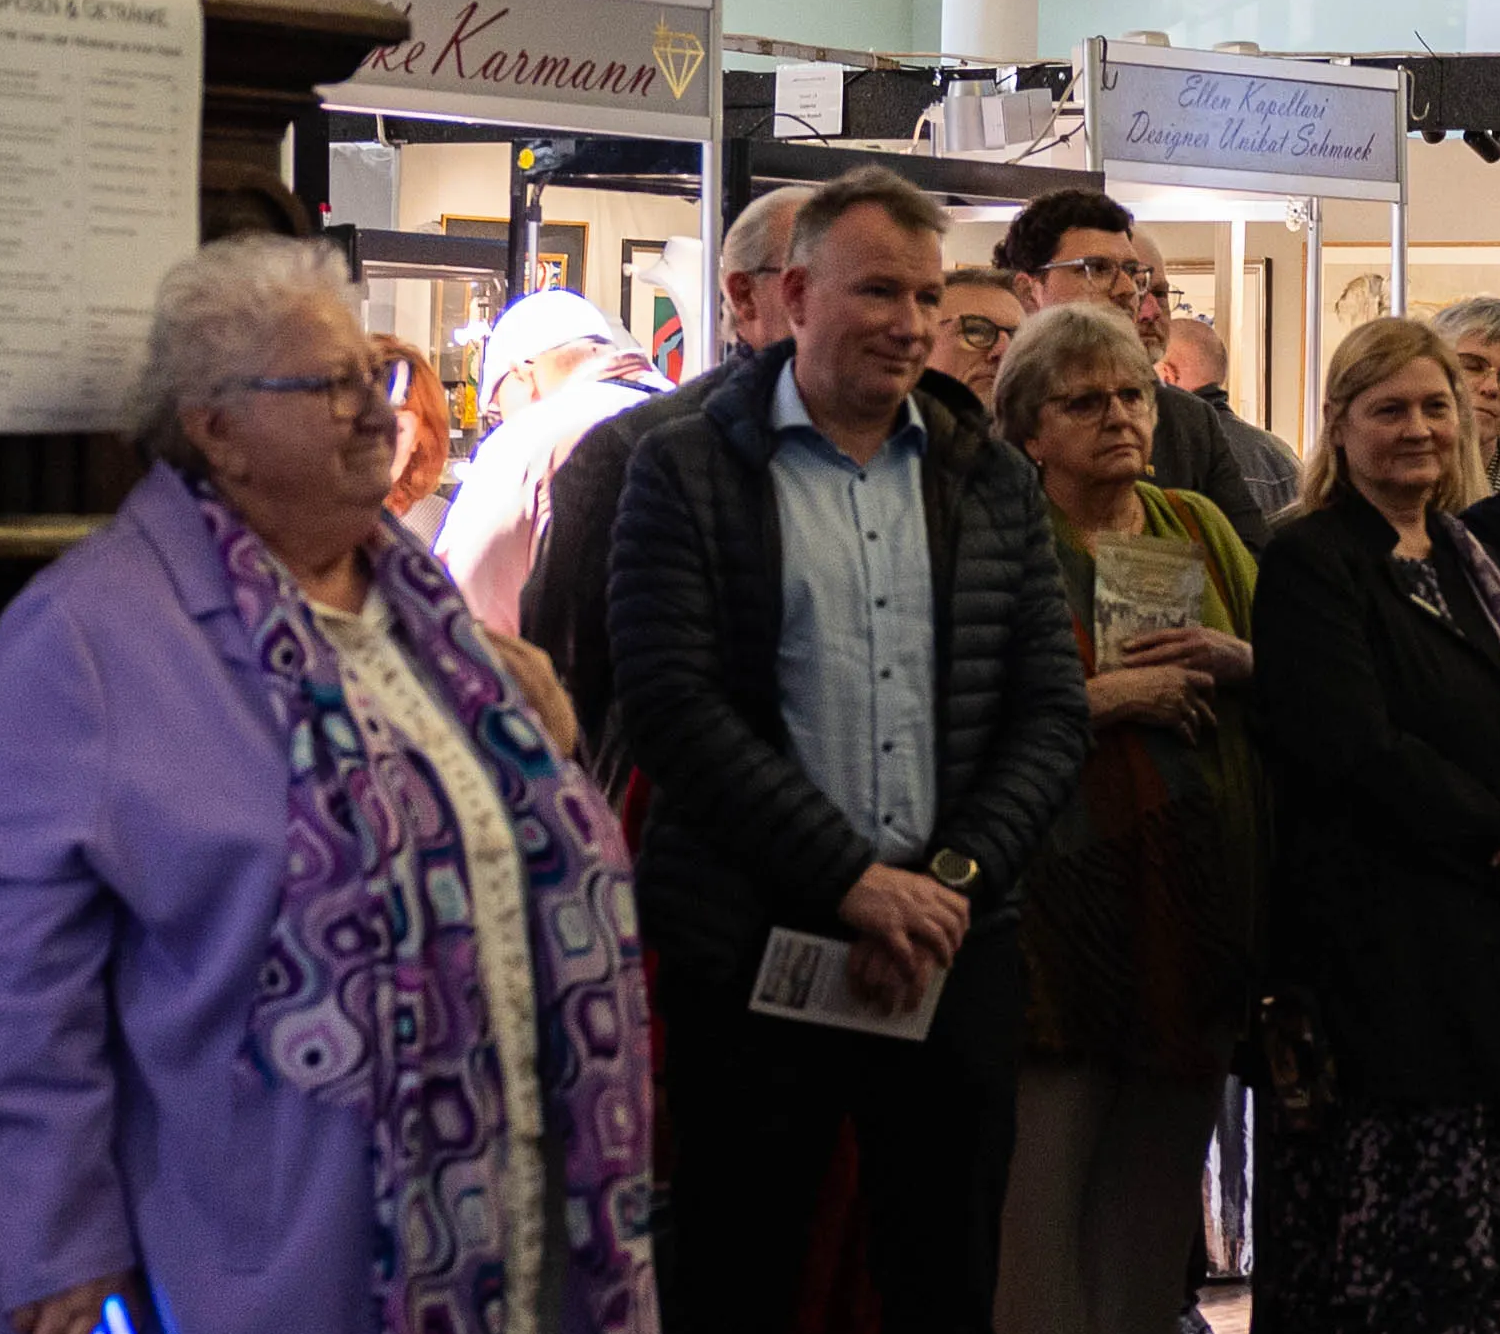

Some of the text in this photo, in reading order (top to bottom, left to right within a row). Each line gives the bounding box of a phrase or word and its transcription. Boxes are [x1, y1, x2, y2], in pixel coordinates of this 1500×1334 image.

[431, 1, 657, 97] Karmann
[1177, 73, 1330, 125] Ellen Kapellari
[1125, 109, 1377, 162] Designer Unikat Schmuck
